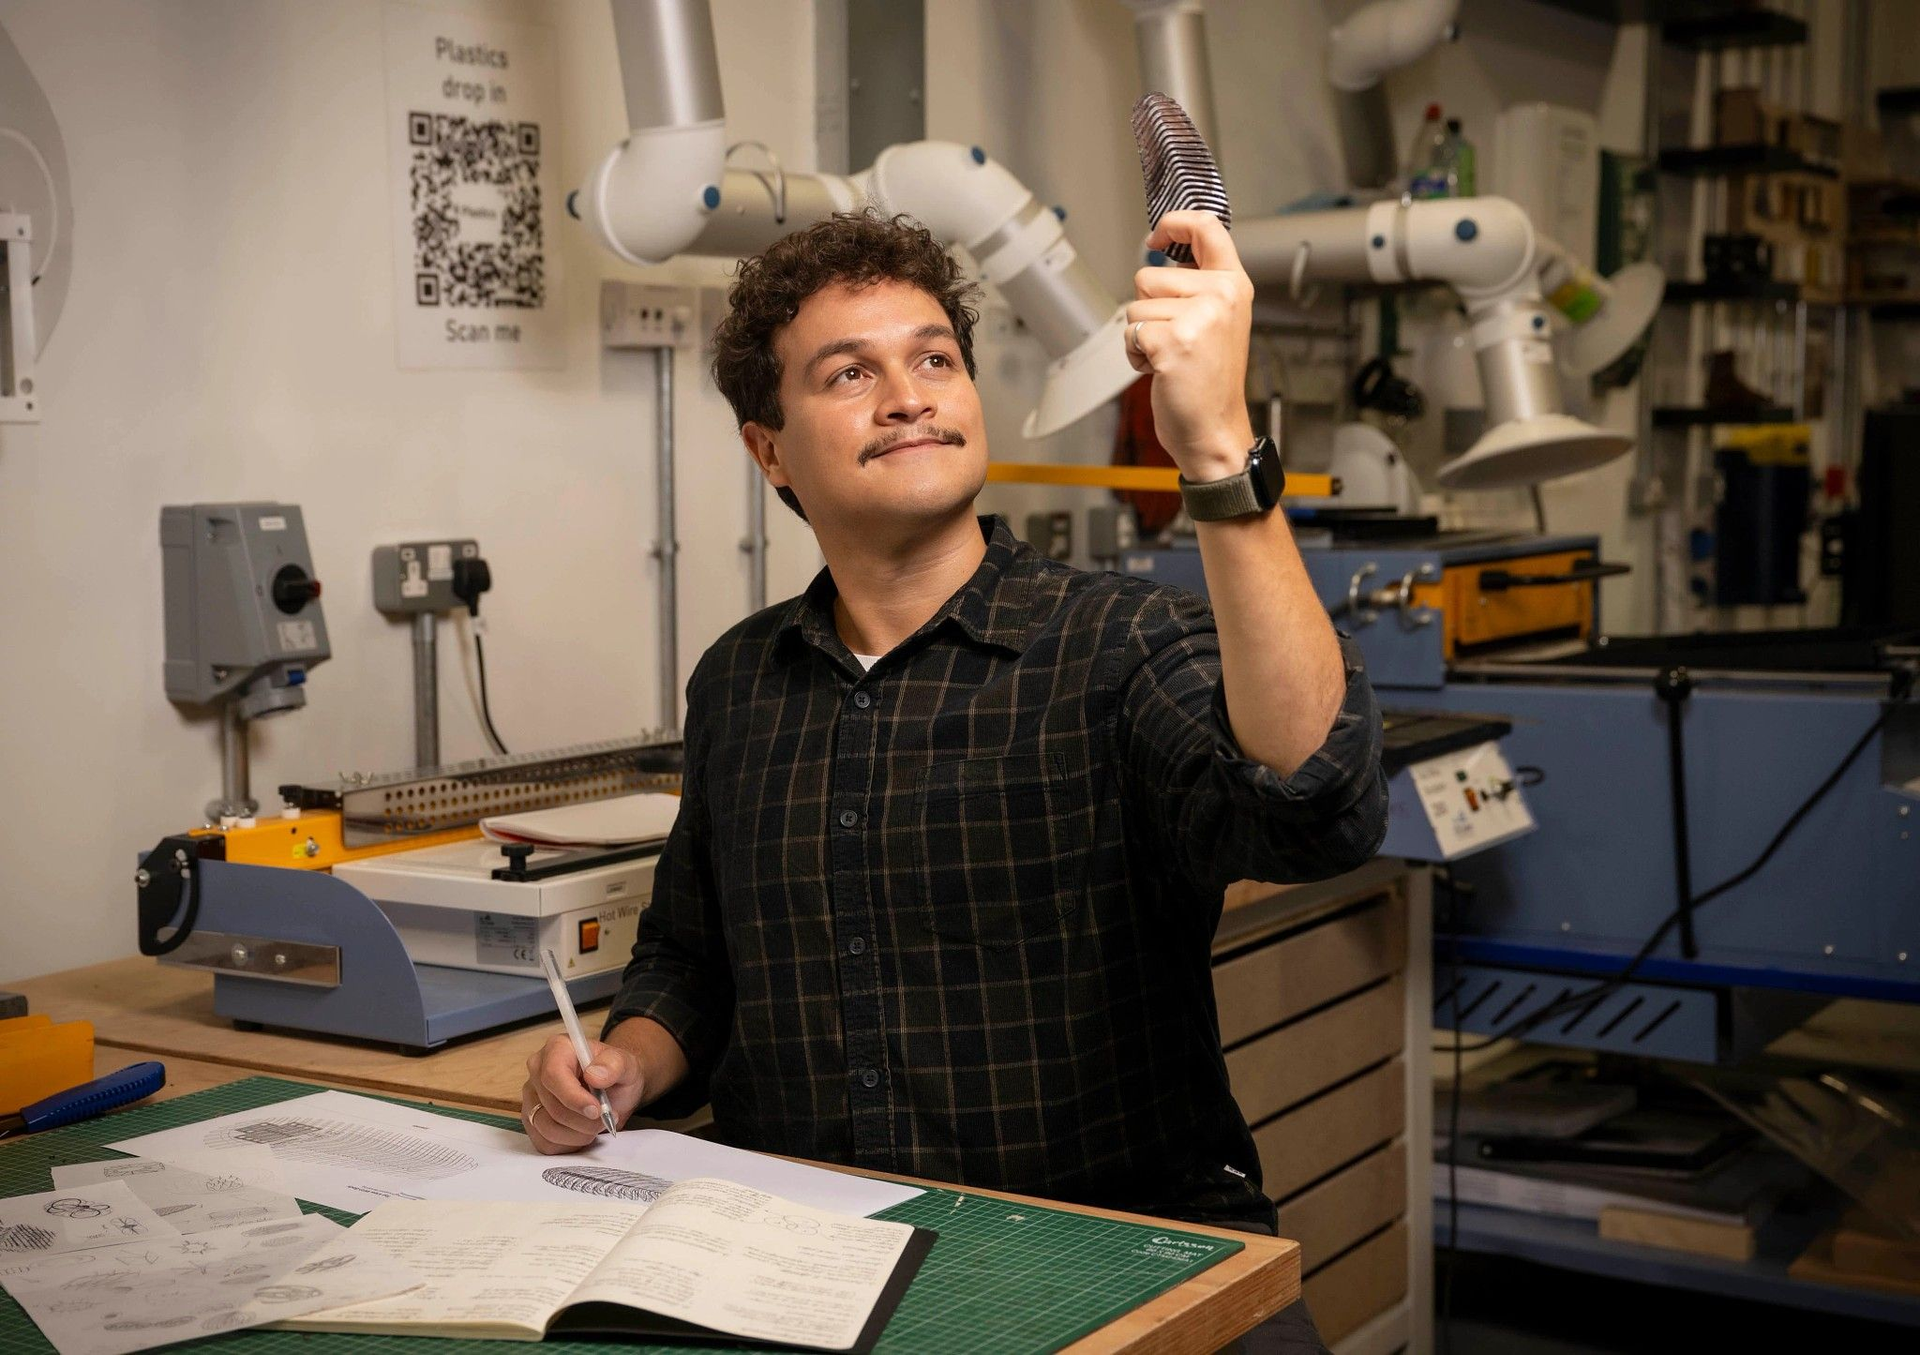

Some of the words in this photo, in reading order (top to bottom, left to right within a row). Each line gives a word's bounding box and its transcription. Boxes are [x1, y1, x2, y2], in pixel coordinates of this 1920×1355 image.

[435, 36, 508, 69] Plastics
[442, 76, 485, 105] drop
[489, 80, 507, 102] in
[445, 318, 490, 342] Scan
[495, 324, 521, 342] me
[600, 909, 616, 921] Hot
[617, 904, 638, 918] Wire
